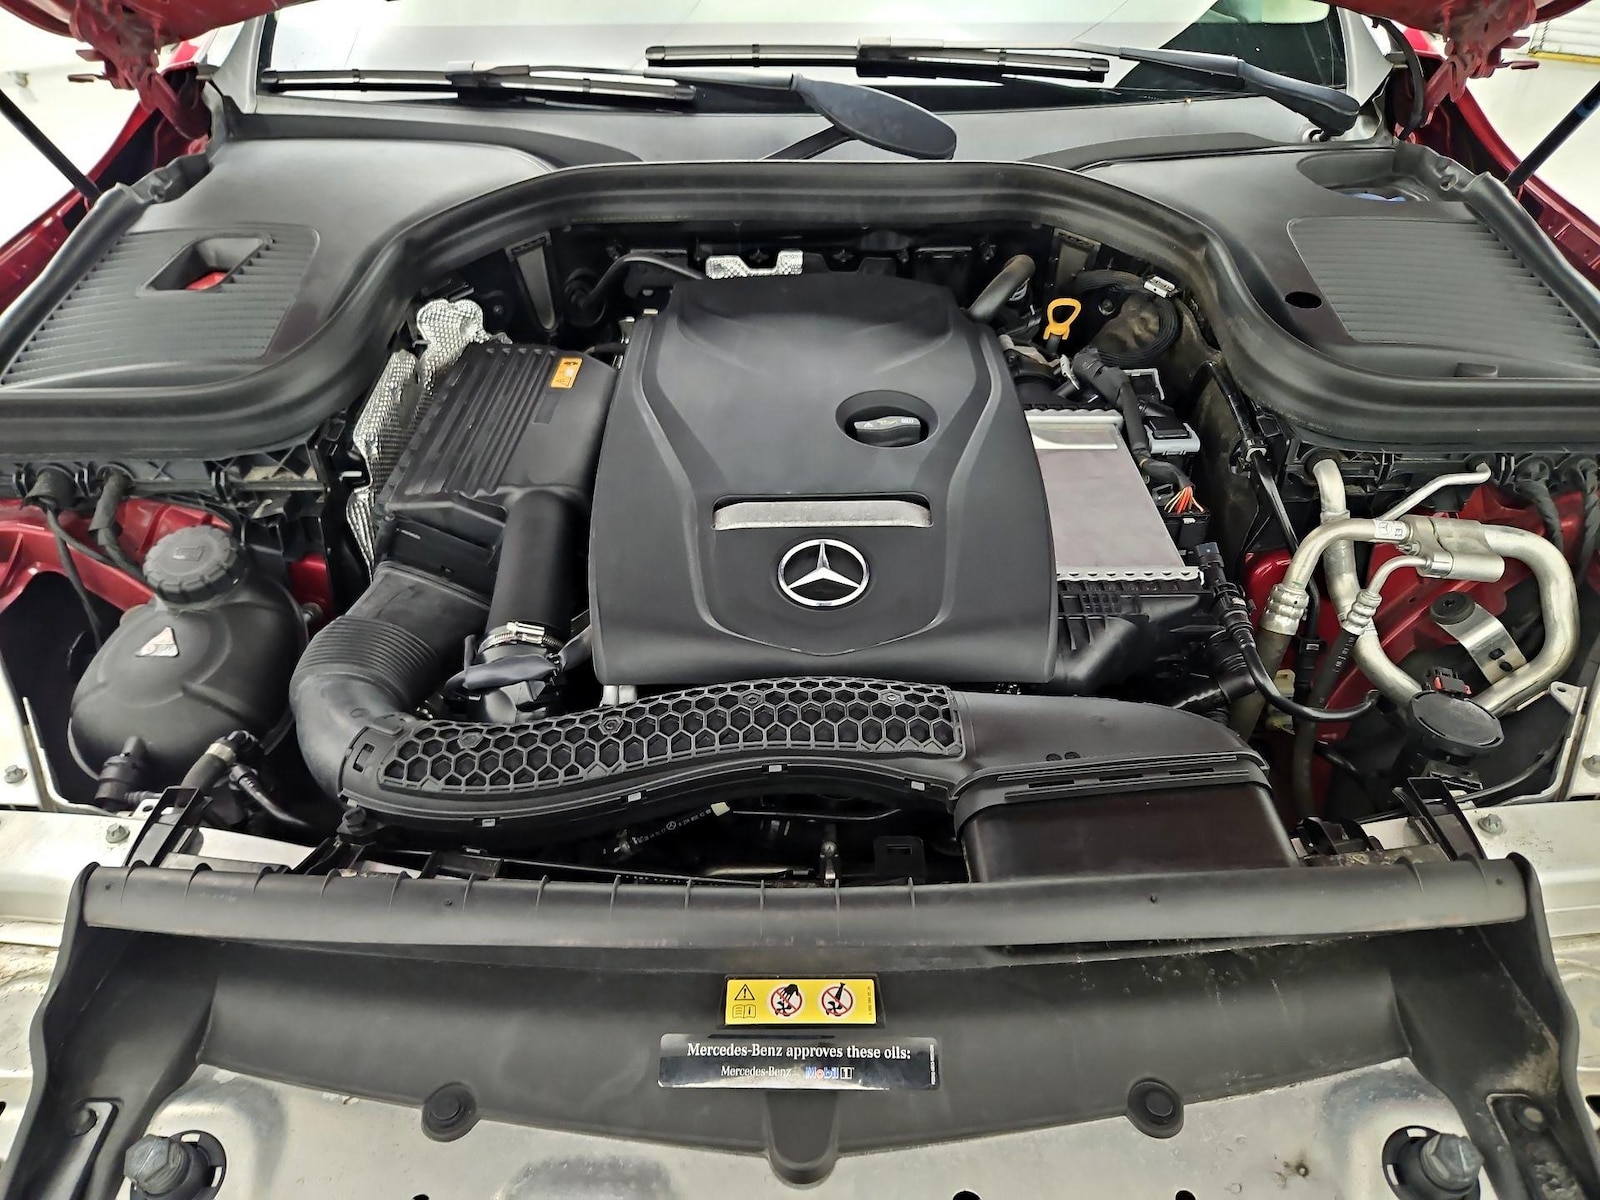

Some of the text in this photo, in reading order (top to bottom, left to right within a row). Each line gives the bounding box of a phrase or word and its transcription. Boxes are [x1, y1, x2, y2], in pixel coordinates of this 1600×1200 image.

[687, 1042, 911, 1060] Mercedes-Benz approves these oils:
[721, 1065, 792, 1077] Mercedes-Benz
